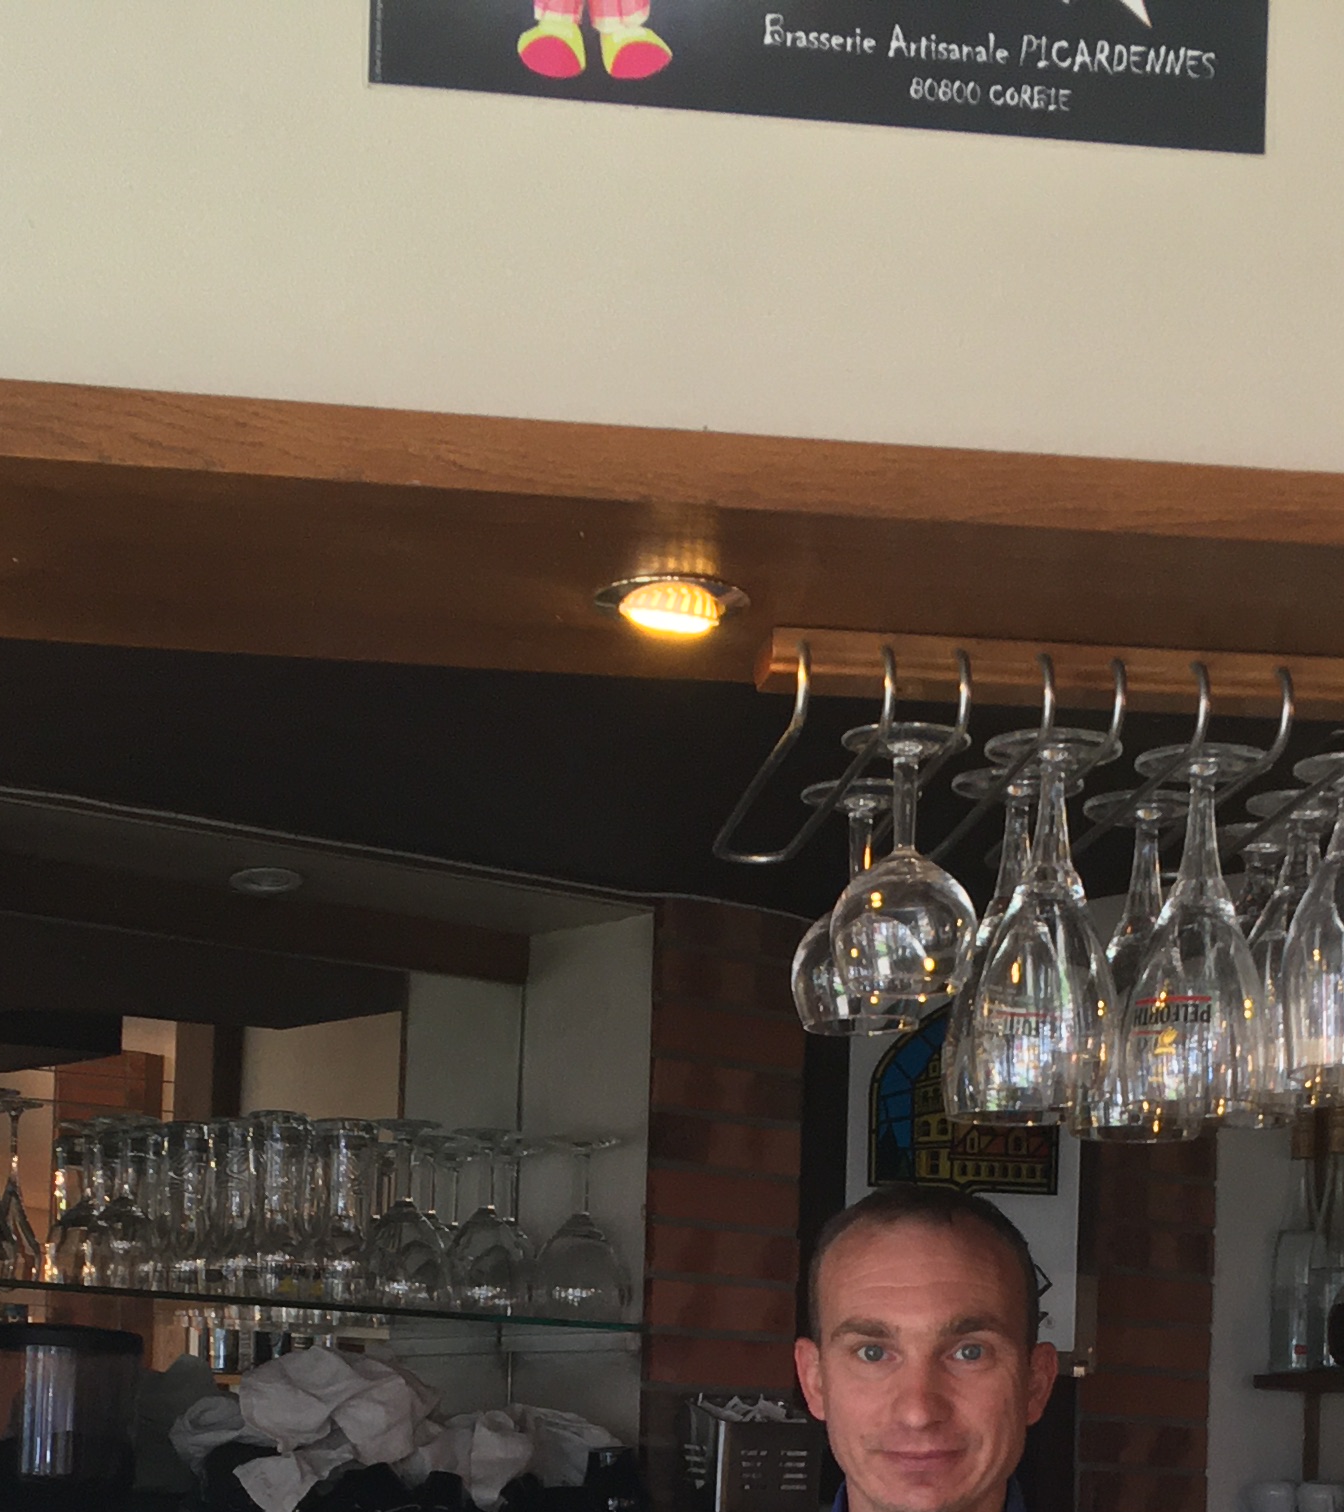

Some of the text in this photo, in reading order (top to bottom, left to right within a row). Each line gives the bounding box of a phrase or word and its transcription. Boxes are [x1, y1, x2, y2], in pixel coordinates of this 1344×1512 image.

[763, 12, 1217, 80] Brasserie Artisanale PICARDENNES
[909, 76, 981, 105] 80800
